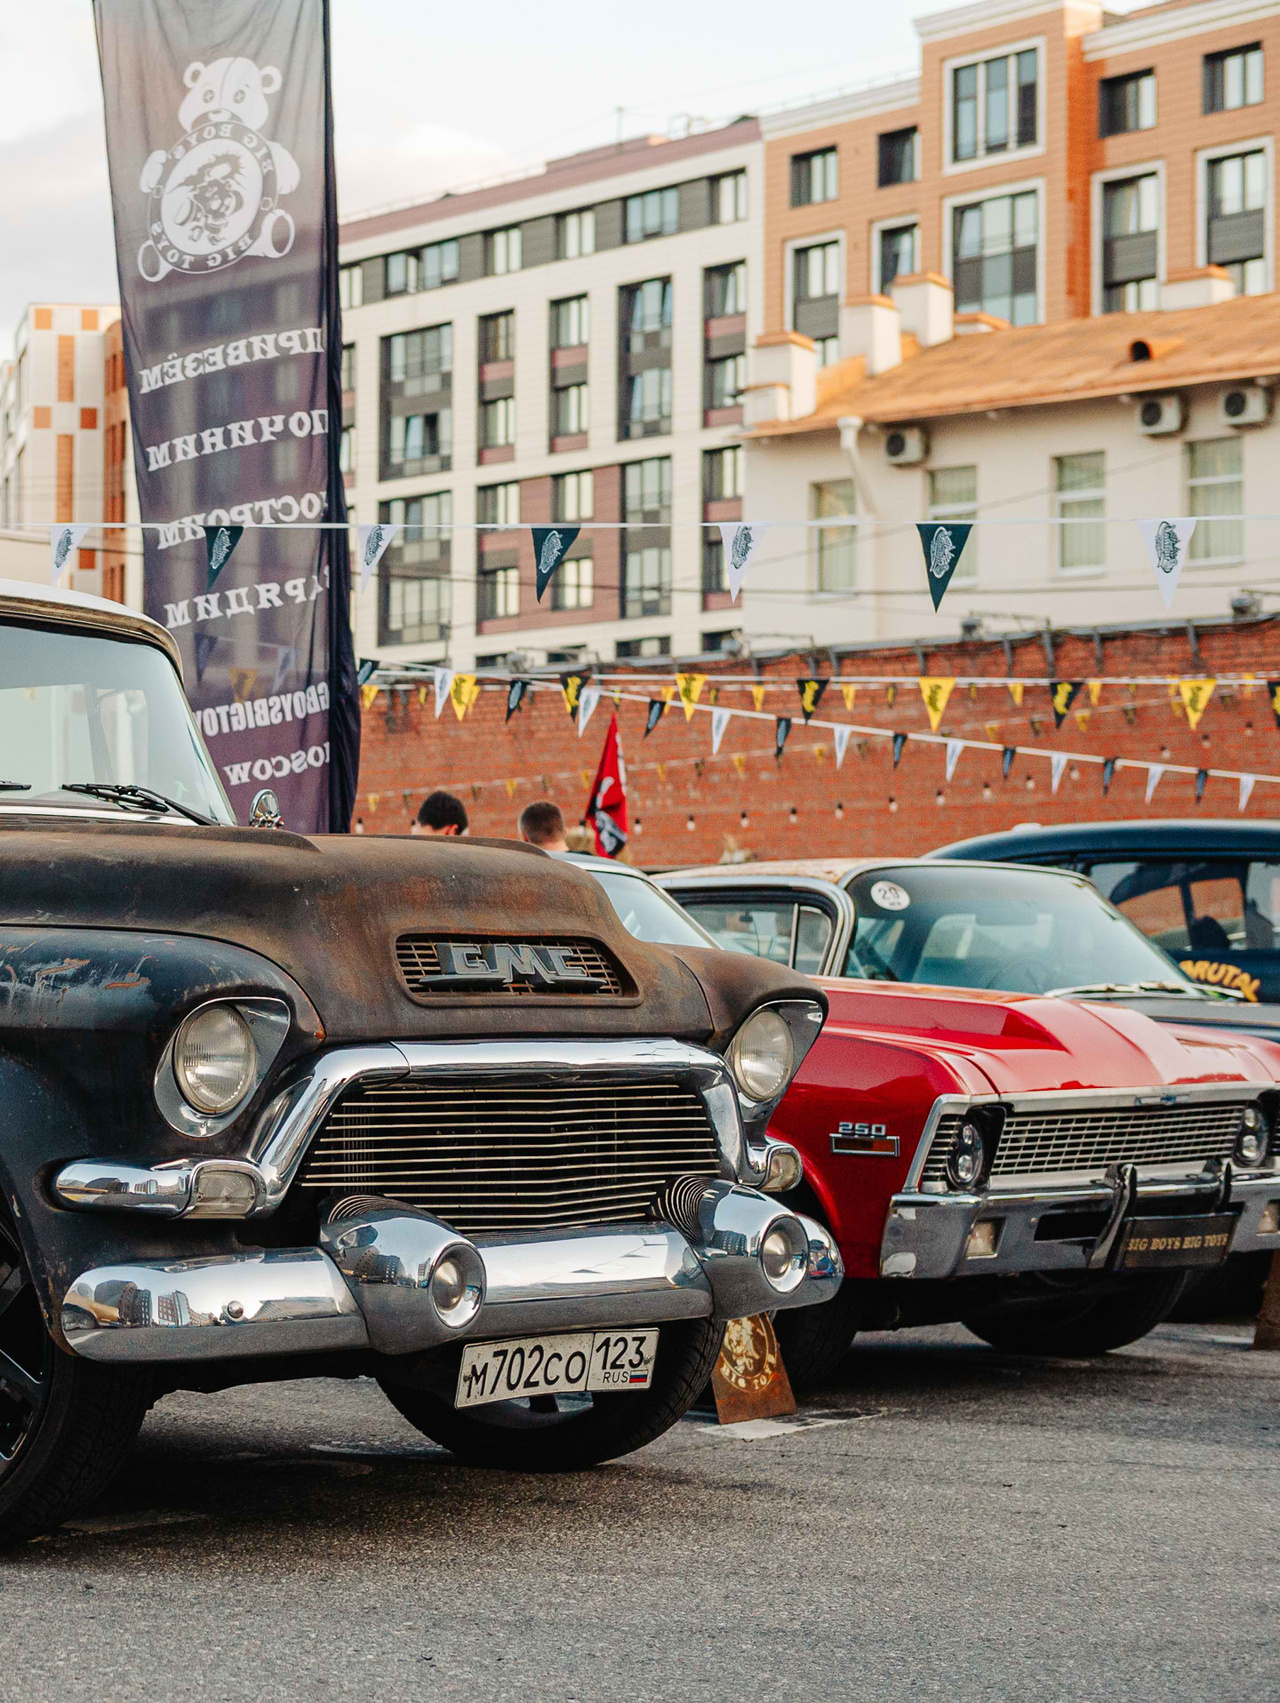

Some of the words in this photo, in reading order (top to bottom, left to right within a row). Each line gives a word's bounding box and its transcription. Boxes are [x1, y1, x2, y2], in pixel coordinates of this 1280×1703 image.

[436, 943, 590, 984] GMC
[838, 1121, 887, 1136] 250
[1151, 1237, 1181, 1250] BOYS
[595, 1336, 647, 1370] 123
[602, 1372, 629, 1384] RUS
